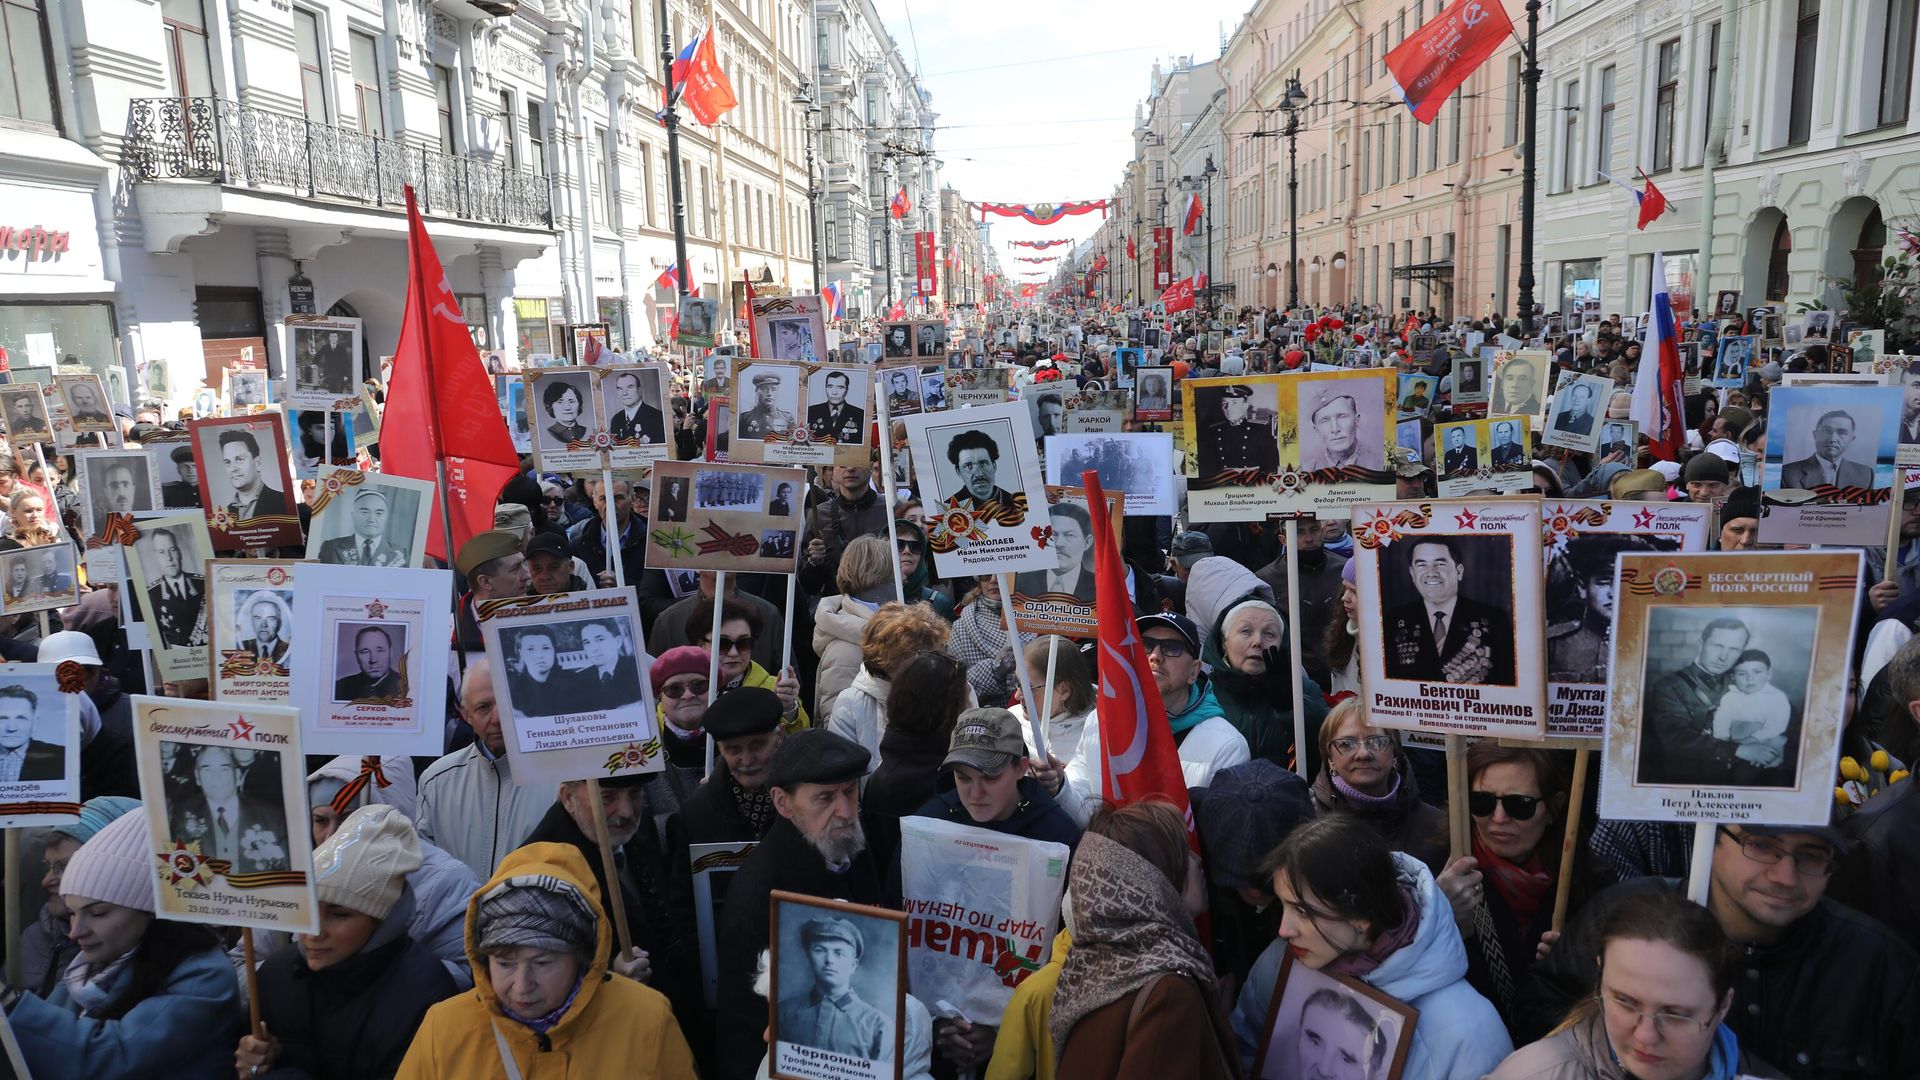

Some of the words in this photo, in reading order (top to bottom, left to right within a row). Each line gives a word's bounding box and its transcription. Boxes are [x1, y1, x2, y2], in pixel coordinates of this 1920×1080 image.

[290, 285, 313, 293] НЕВСКИЙ
[1078, 416, 1111, 424] ЖАРКОЙ
[1228, 499, 1278, 507] Владимирович
[1480, 522, 1507, 530] ПОЛК
[1656, 522, 1681, 530] ПОЛК
[968, 537, 1015, 548] НИКОЛАЕВ
[979, 545, 1030, 555] Николаевич
[963, 555, 997, 564] Рядовой,
[998, 553, 1028, 562] стрелок
[1708, 570, 1814, 583] БЕССМЕРТНЫЙ
[1710, 583, 1749, 593] ПОЛК
[1751, 583, 1809, 593] РОССИИ
[1025, 602, 1092, 616] ОДИНЦОВ
[1038, 613, 1099, 625] Филиппови
[1419, 683, 1480, 700] Бектош
[1375, 693, 1460, 712] Рахимович
[1463, 699, 1534, 717] Рахимов
[554, 712, 607, 725] Шулаковы
[1371, 707, 1405, 717] Командир
[1463, 715, 1505, 724] стрелковой
[1505, 718, 1537, 726] дивизии
[526, 726, 575, 739] Геннадий
[577, 720, 639, 734] Степанович
[1465, 723, 1487, 731] округа
[254, 731, 289, 744] ПОЛК
[535, 740, 568, 749] Лидия
[570, 733, 635, 746] Анатольевна
[0, 783, 41, 792] омарёв
[1690, 789, 1735, 800] Павлов
[1662, 798, 1691, 810] Петр
[1694, 800, 1763, 810] Алексеевич
[1674, 810, 1720, 819] 30.09.1902
[1730, 811, 1750, 820] 1943
[213, 891, 243, 905] Нуры
[245, 895, 300, 910] Нурыевич
[902, 896, 966, 922] ЦЕНАМ
[968, 910, 994, 929] ПО
[998, 918, 1045, 941] УДАР
[790, 1044, 871, 1070] Червоный
[782, 1054, 820, 1068] Трофим
[822, 1063, 877, 1080] Артёмович
